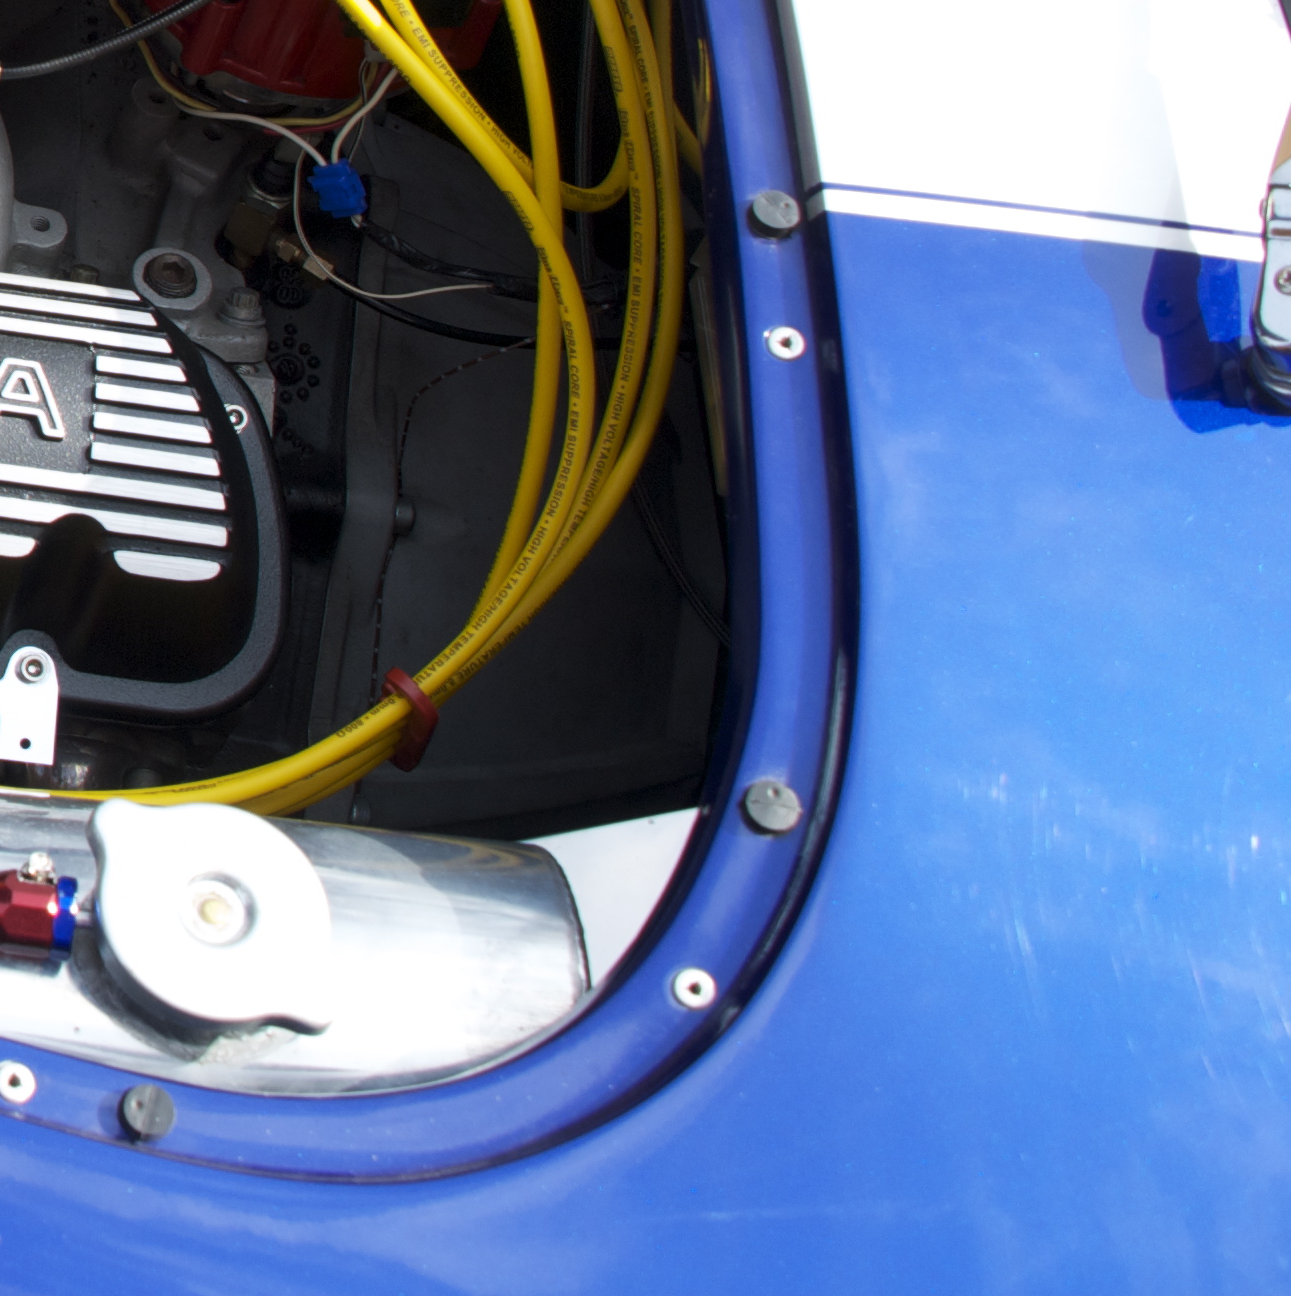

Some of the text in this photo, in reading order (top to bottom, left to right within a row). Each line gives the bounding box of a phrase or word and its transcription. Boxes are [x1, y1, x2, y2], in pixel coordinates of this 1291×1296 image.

[412, 26, 430, 50] EMI
[427, 48, 488, 122] SUPPRESSION
[631, 187, 643, 226] SPIRAL
[632, 231, 643, 266] CORE
[631, 275, 642, 297] EMI
[562, 321, 579, 361] SPIRAL
[620, 300, 640, 382] SUPPRESSION
[570, 365, 581, 400] CORE
[569, 410, 580, 432] EMI
[612, 392, 627, 421] HIGH
[546, 434, 579, 518] SUPPRESSION
[527, 526, 547, 554] HIGH
[473, 555, 532, 631] VOLTAGE/HIGH
